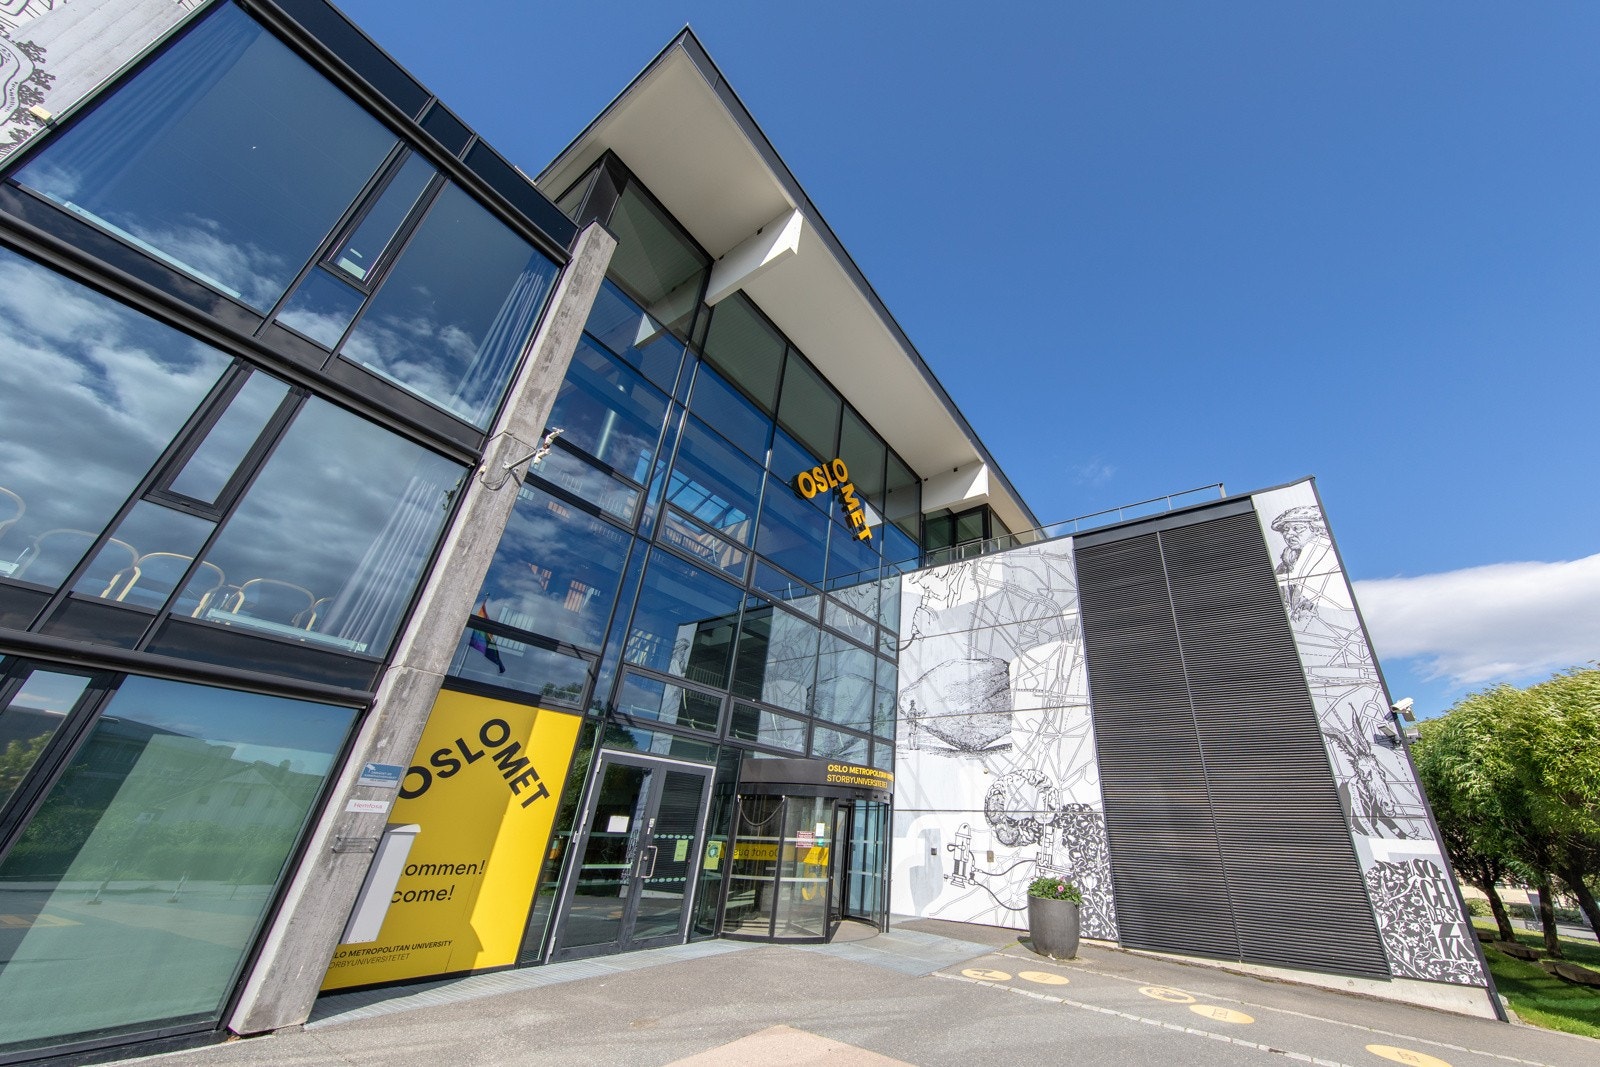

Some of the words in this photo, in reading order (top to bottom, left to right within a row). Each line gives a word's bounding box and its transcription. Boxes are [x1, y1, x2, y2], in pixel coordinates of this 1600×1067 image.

[827, 764, 849, 773] OSLO
[401, 859, 486, 877] ommen!
[333, 950, 347, 959] LO
[348, 944, 411, 957] METROPOLITAN
[411, 940, 453, 951] UNIVERSITY
